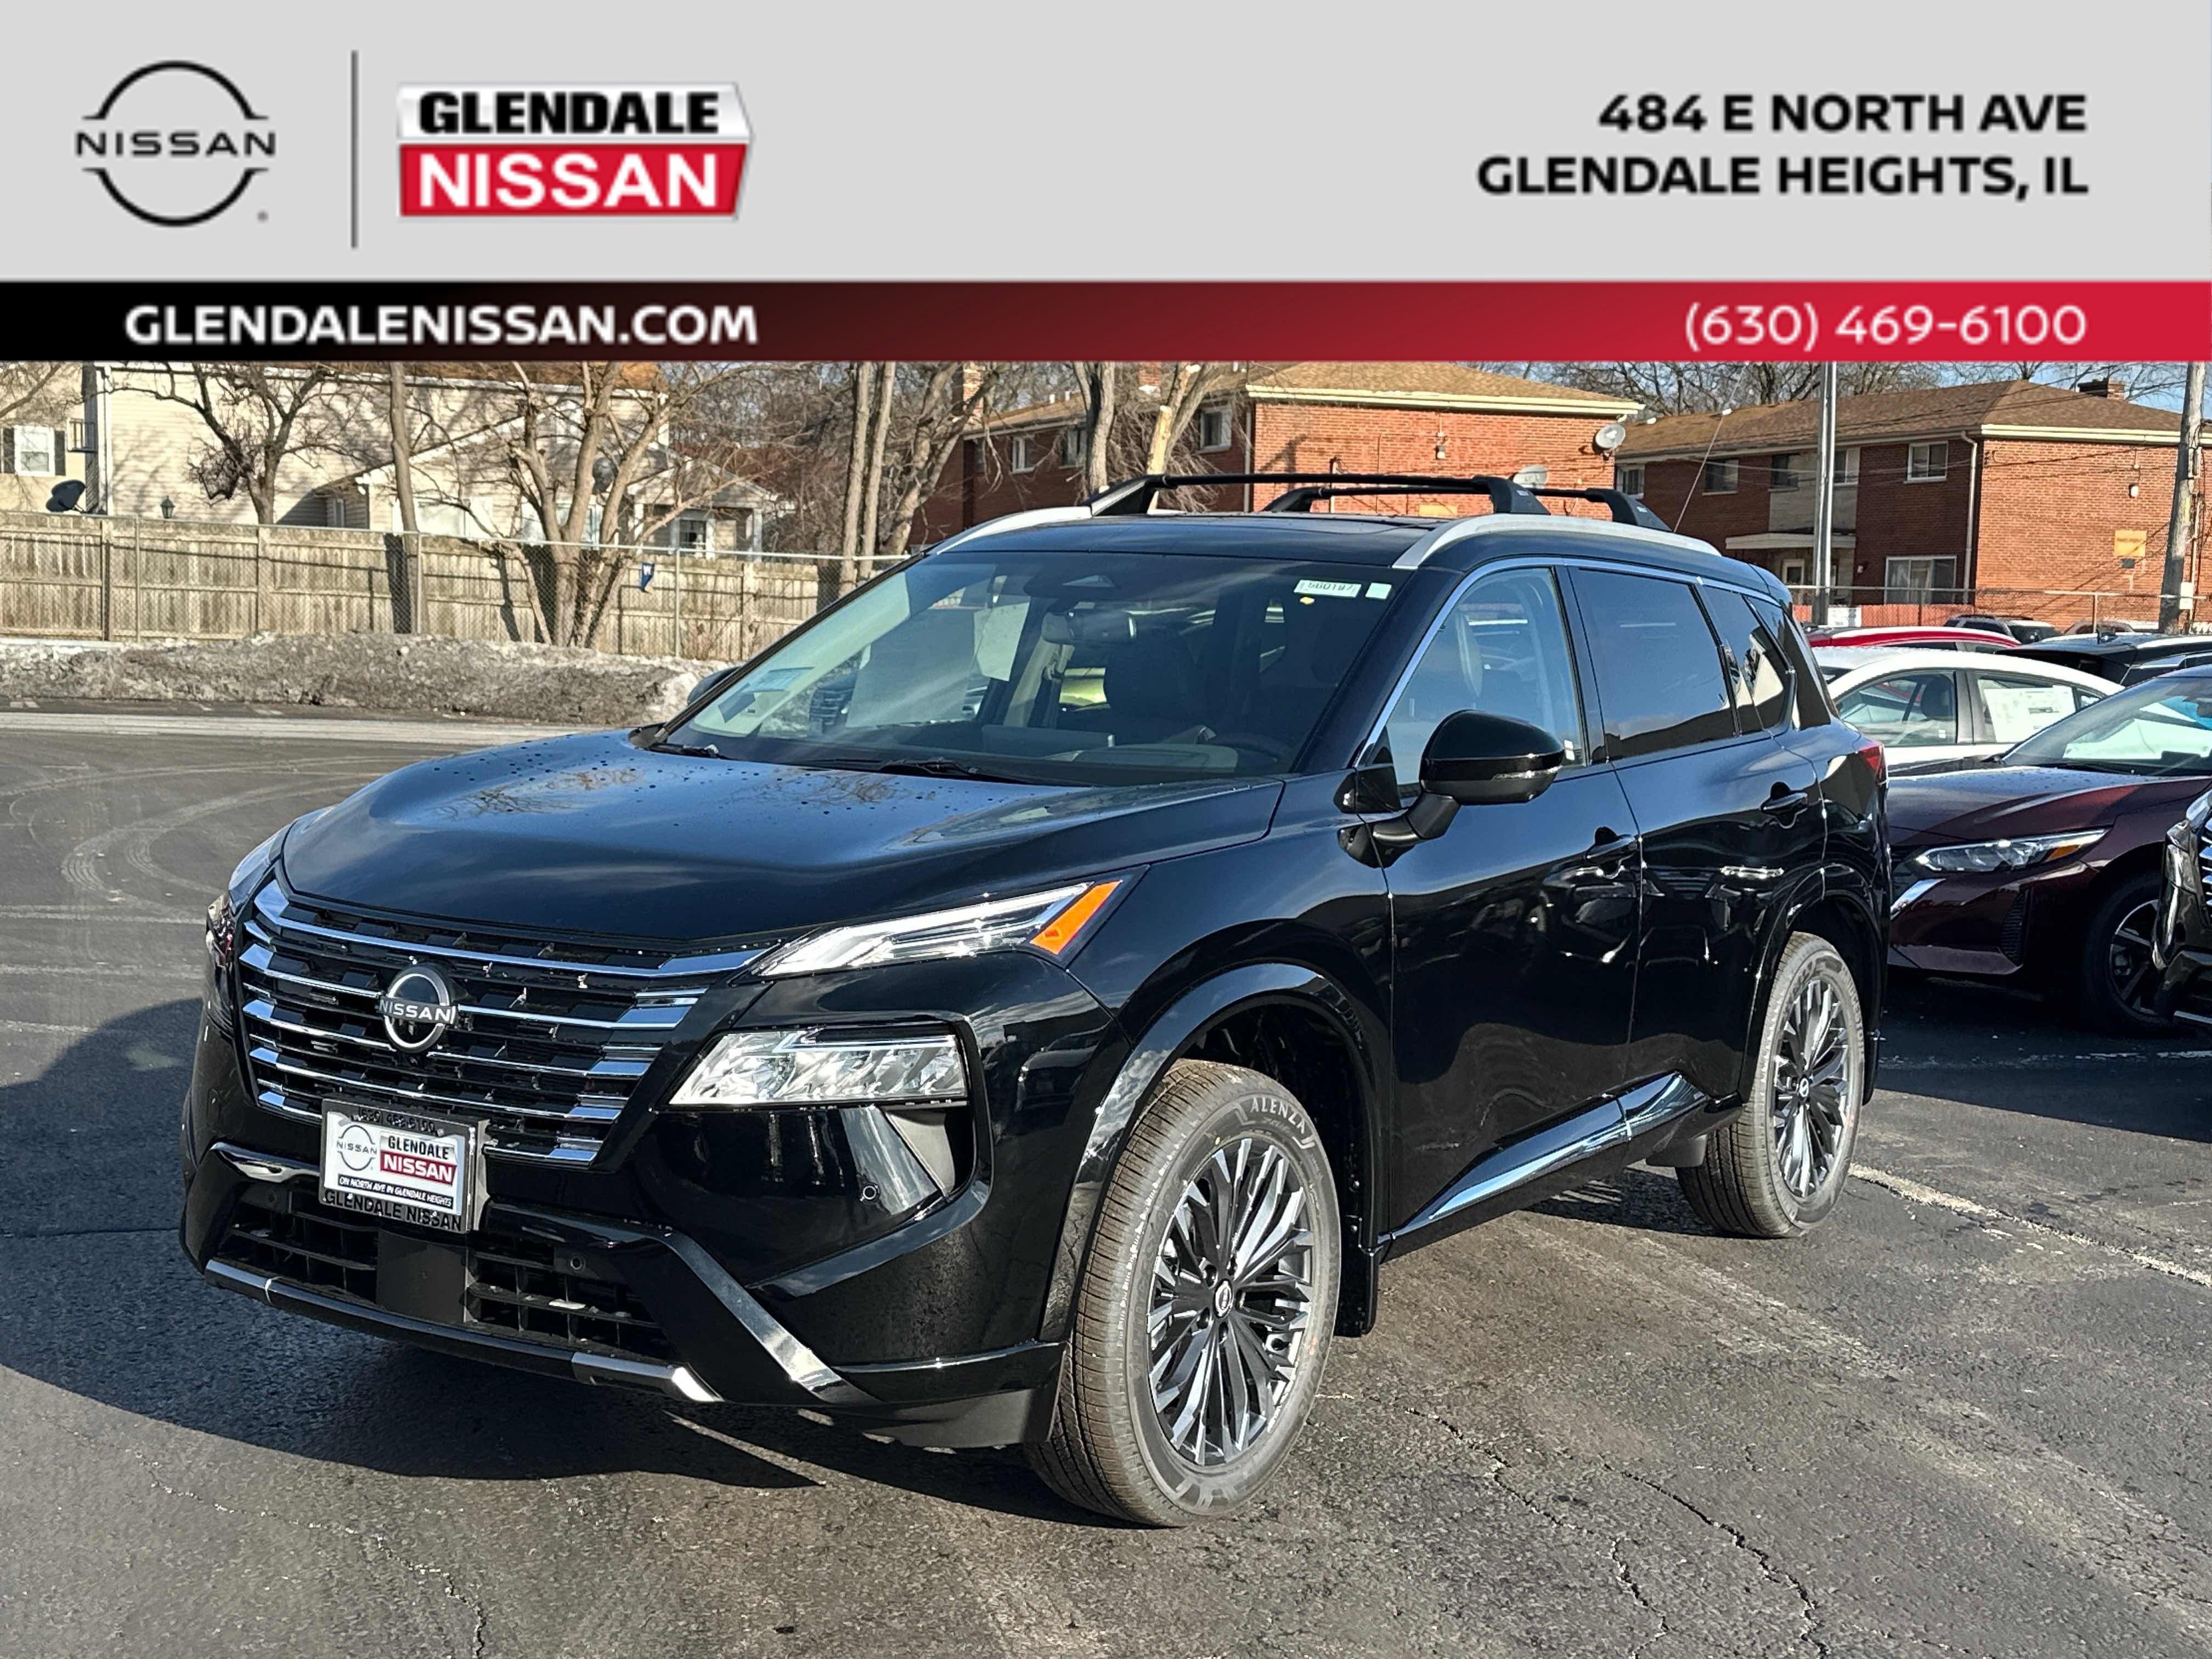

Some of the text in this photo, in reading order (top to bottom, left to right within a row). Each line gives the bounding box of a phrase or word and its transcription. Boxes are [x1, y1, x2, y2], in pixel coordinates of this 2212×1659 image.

[379, 998, 452, 1023] NISSAN
[1250, 1097, 1306, 1134] ALENZA
[336, 1140, 377, 1155] NISSAN
[388, 1135, 449, 1160] GLENDALE
[384, 1154, 452, 1182] NISSAN
[324, 1188, 461, 1232] GLENDALE NISSAN
